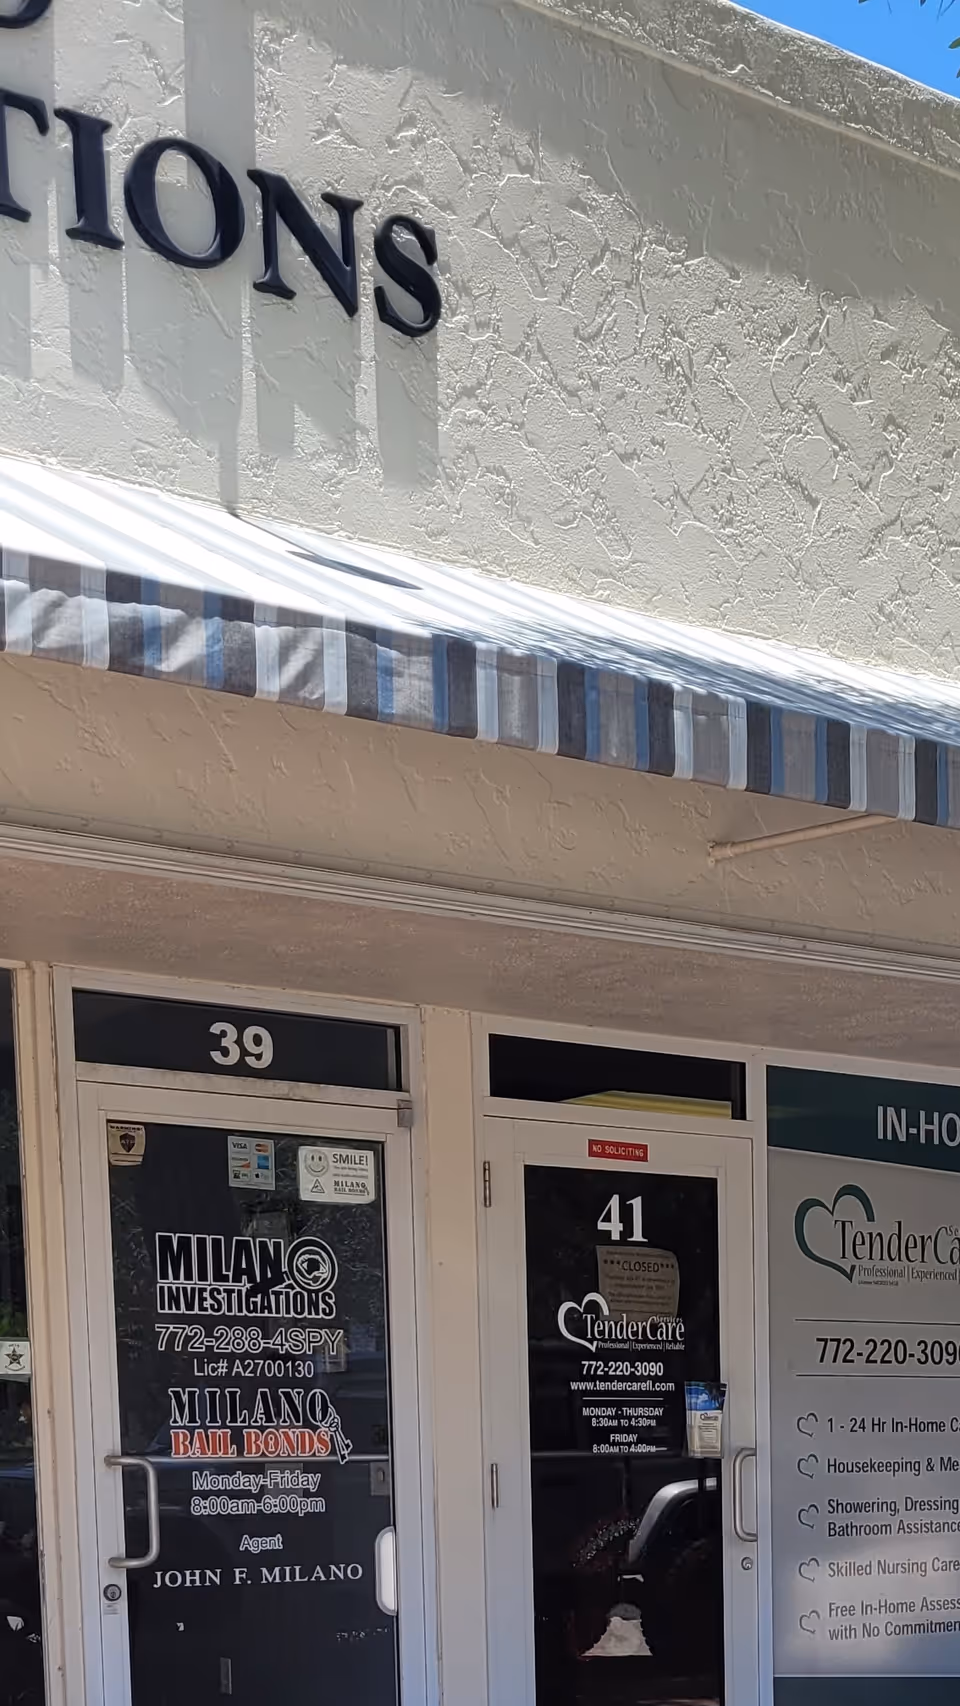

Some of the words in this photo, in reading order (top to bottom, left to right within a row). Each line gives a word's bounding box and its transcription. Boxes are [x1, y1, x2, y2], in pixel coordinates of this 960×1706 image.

[209, 1022, 274, 1068] 39
[332, 1153, 368, 1166] SMILE!
[592, 1144, 602, 1153] NO
[604, 1145, 644, 1157] SOLICITING
[597, 1194, 648, 1242] 41
[858, 1264, 906, 1278] Professional
[911, 1267, 957, 1281] Experienced
[157, 1283, 336, 1319] INVESTIGATIONS
[582, 1313, 685, 1341] TenderCare
[155, 1324, 343, 1354] 772-288-4SPY
[193, 1359, 229, 1377] Lic#
[232, 1359, 314, 1378] A2700130
[581, 1361, 664, 1376] 772-220-3090
[570, 1380, 675, 1391] www.tendercarefl.com
[169, 1388, 330, 1426] MILANO
[582, 1407, 616, 1416] MONDAY
[622, 1407, 664, 1416] THURSDAY
[827, 1417, 834, 1432] 1
[849, 1418, 866, 1432] 24
[871, 1417, 886, 1433] Hr
[891, 1417, 946, 1433] In-Home
[170, 1429, 237, 1458] BAIL
[244, 1428, 331, 1457] BONDS
[610, 1434, 638, 1443] FRIDAY
[827, 1457, 921, 1477] Housekeeping
[925, 1457, 935, 1472] &
[192, 1470, 321, 1491] Monday-Friday
[190, 1496, 326, 1516] 8:00am-6:00pm
[827, 1498, 900, 1517] Showering,
[904, 1496, 959, 1515] Dressing
[828, 1521, 892, 1538] Bathroom
[239, 1534, 283, 1554] Agent
[153, 1569, 222, 1589] JOHN
[233, 1567, 252, 1585] F.
[259, 1563, 364, 1584] MILANO
[828, 1561, 872, 1578] Skilled
[876, 1559, 928, 1577] Nursing
[931, 1557, 960, 1572] Care
[828, 1602, 856, 1618] Free
[860, 1599, 916, 1616] In-Home
[828, 1624, 857, 1641] with
[862, 1623, 880, 1638] No
